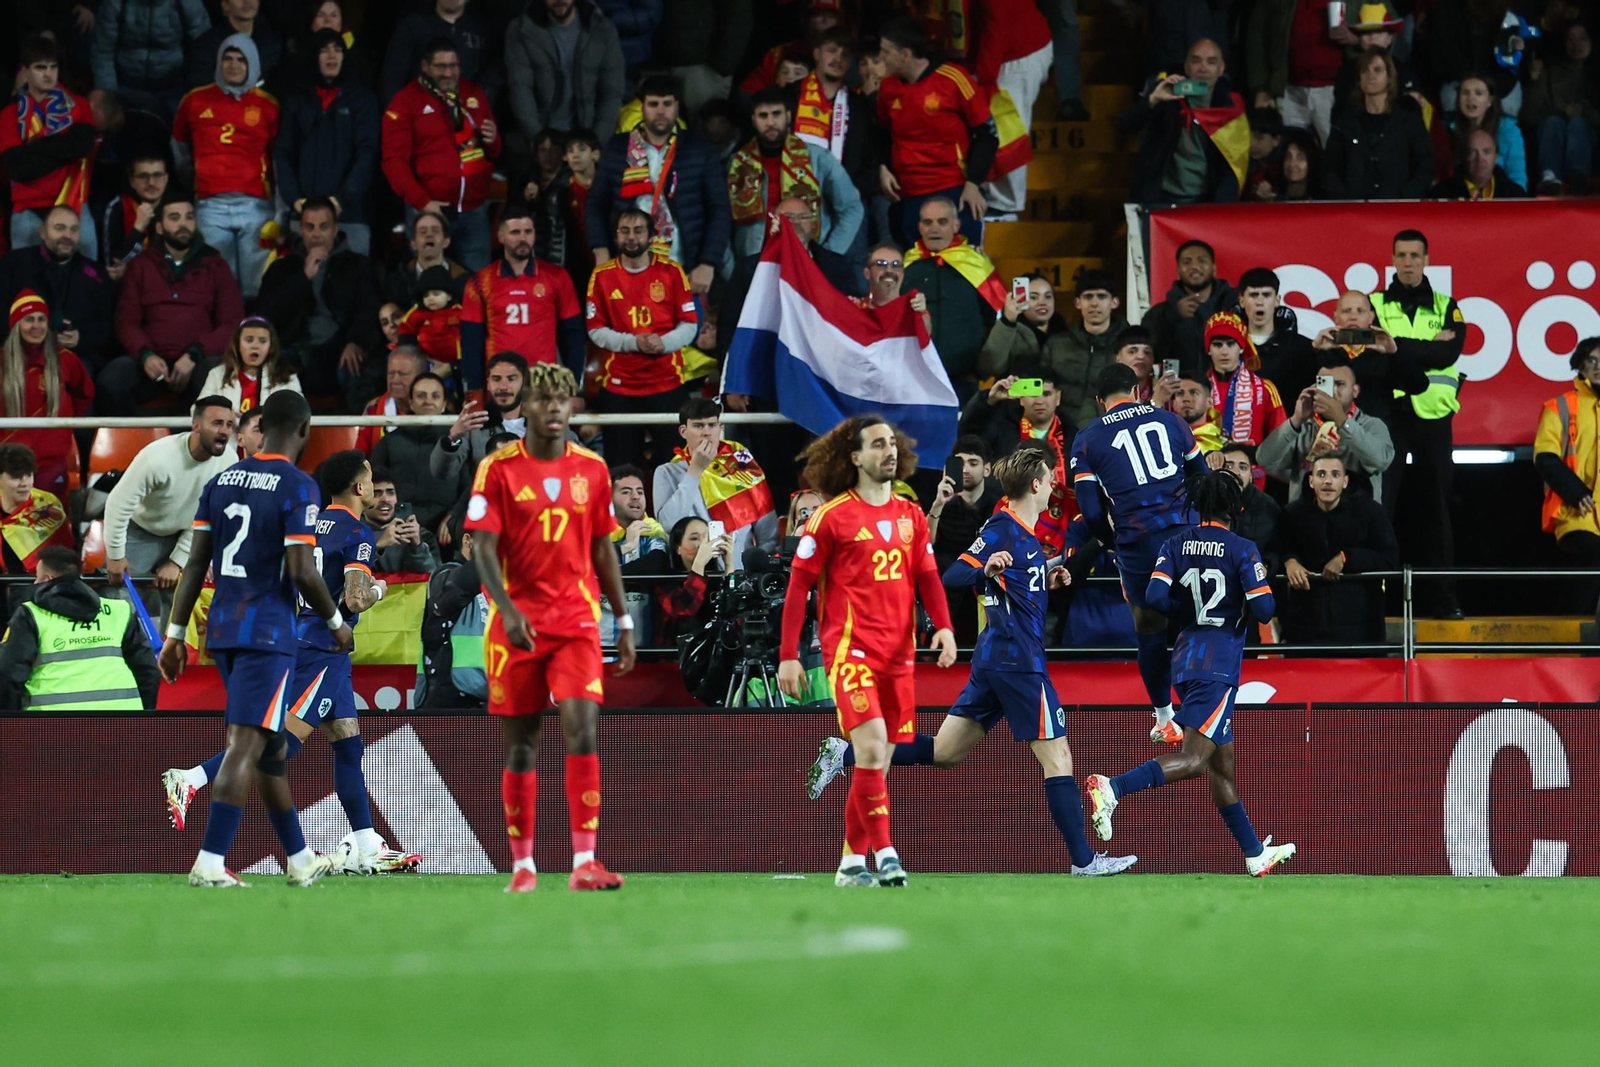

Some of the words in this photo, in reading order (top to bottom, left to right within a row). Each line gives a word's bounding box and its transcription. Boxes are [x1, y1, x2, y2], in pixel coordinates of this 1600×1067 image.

[219, 122, 236, 145] 2
[505, 302, 530, 325] 21
[627, 305, 652, 329] 10
[1101, 404, 1155, 426] MEMPHIS
[1110, 420, 1178, 486] 10
[216, 468, 282, 492] GEERTRUIDA
[537, 507, 570, 543] 17
[220, 502, 252, 579] 2
[872, 547, 903, 582] 22
[1026, 564, 1046, 592] 21
[1178, 567, 1227, 627] 12
[68, 618, 101, 632] 741
[839, 662, 876, 693] 22
